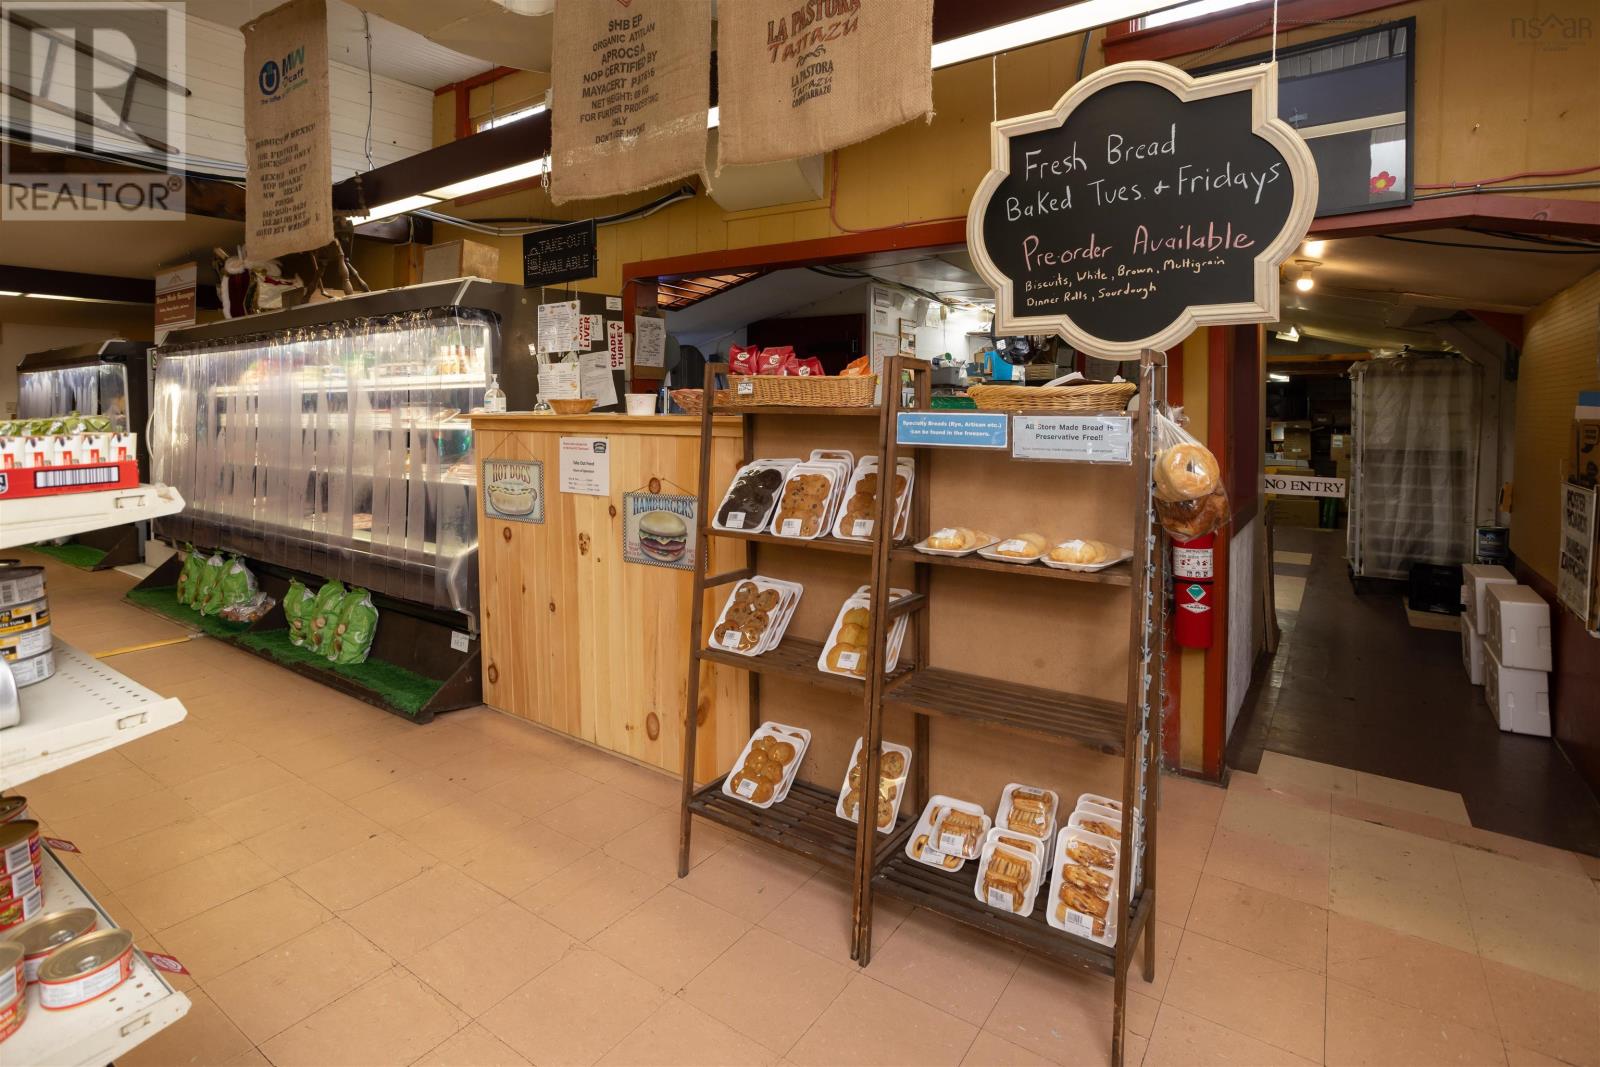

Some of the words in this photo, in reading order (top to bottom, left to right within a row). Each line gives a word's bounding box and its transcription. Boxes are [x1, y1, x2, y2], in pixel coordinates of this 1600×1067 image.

[608, 19, 630, 32] SHB
[632, 14, 643, 28] EP
[592, 34, 626, 52] ORGANIC
[601, 42, 645, 65] APROCSA
[583, 70, 604, 84] NOP
[605, 57, 647, 78] CERTIFIED
[647, 50, 658, 63] BY
[800, 60, 834, 82] PASTORA
[582, 78, 627, 98] MAYACERT
[591, 98, 605, 109] NET
[580, 112, 597, 123] FOR
[1025, 141, 1088, 182] Fresh
[1106, 123, 1177, 165] Bread
[1178, 161, 1282, 205] Fridays
[1132, 221, 1256, 255] Available
[1025, 272, 1072, 292] Biscuits,
[1163, 256, 1225, 273] Multigrain
[1026, 296, 1059, 307] Dinner
[1098, 282, 1157, 300] Sourdough
[583, 316, 591, 348] LIVER
[609, 322, 616, 330] A
[1035, 433, 1080, 441] Preservative
[492, 463, 507, 483] HOT
[509, 464, 531, 484] DOGS
[1264, 479, 1287, 490] NO
[1290, 480, 1344, 493] ENTRY
[633, 496, 694, 519] HAMBURGERS
